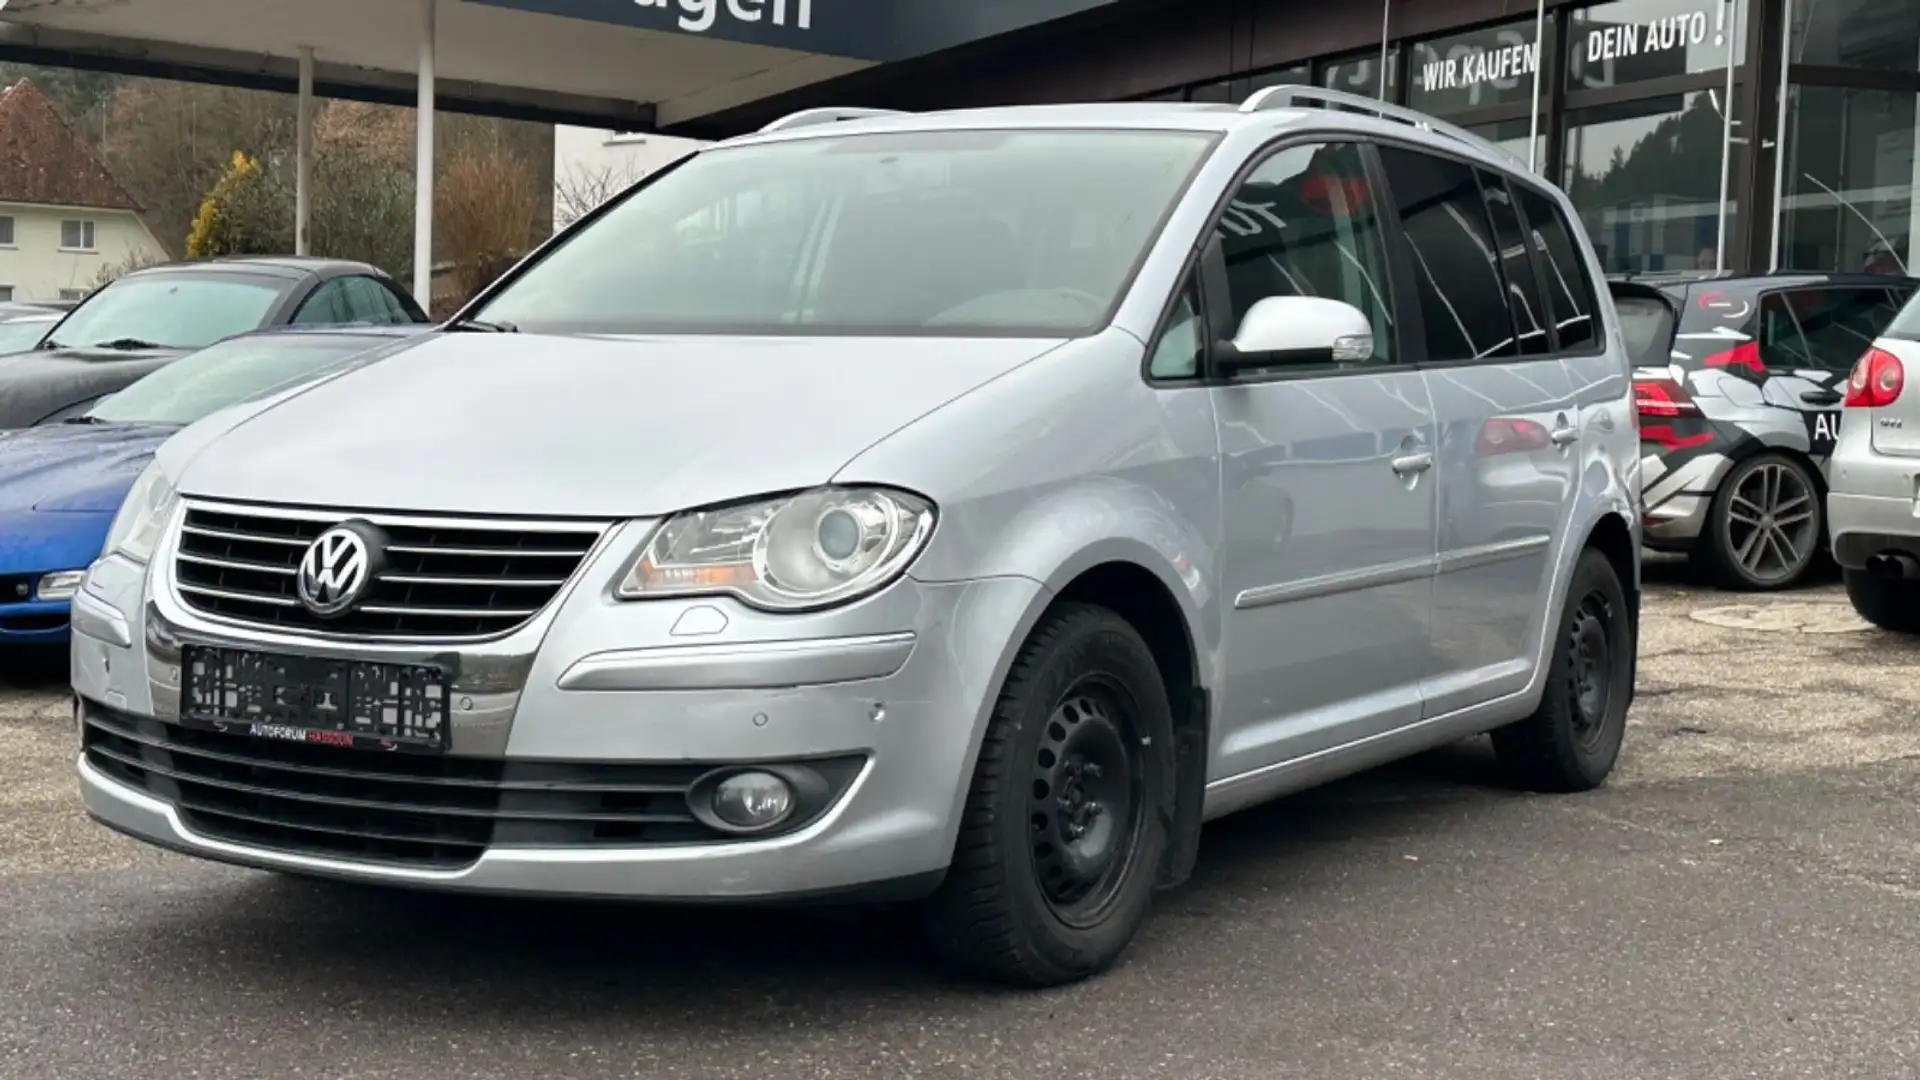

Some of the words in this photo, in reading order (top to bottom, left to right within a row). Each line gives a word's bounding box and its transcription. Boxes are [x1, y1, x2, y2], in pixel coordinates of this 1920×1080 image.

[1423, 59, 1457, 92] WIR
[1462, 43, 1538, 85] KAUFEN
[1587, 23, 1639, 62] DEIN
[1643, 10, 1708, 53] AUTO
[249, 723, 307, 741] AUTOFORUM
